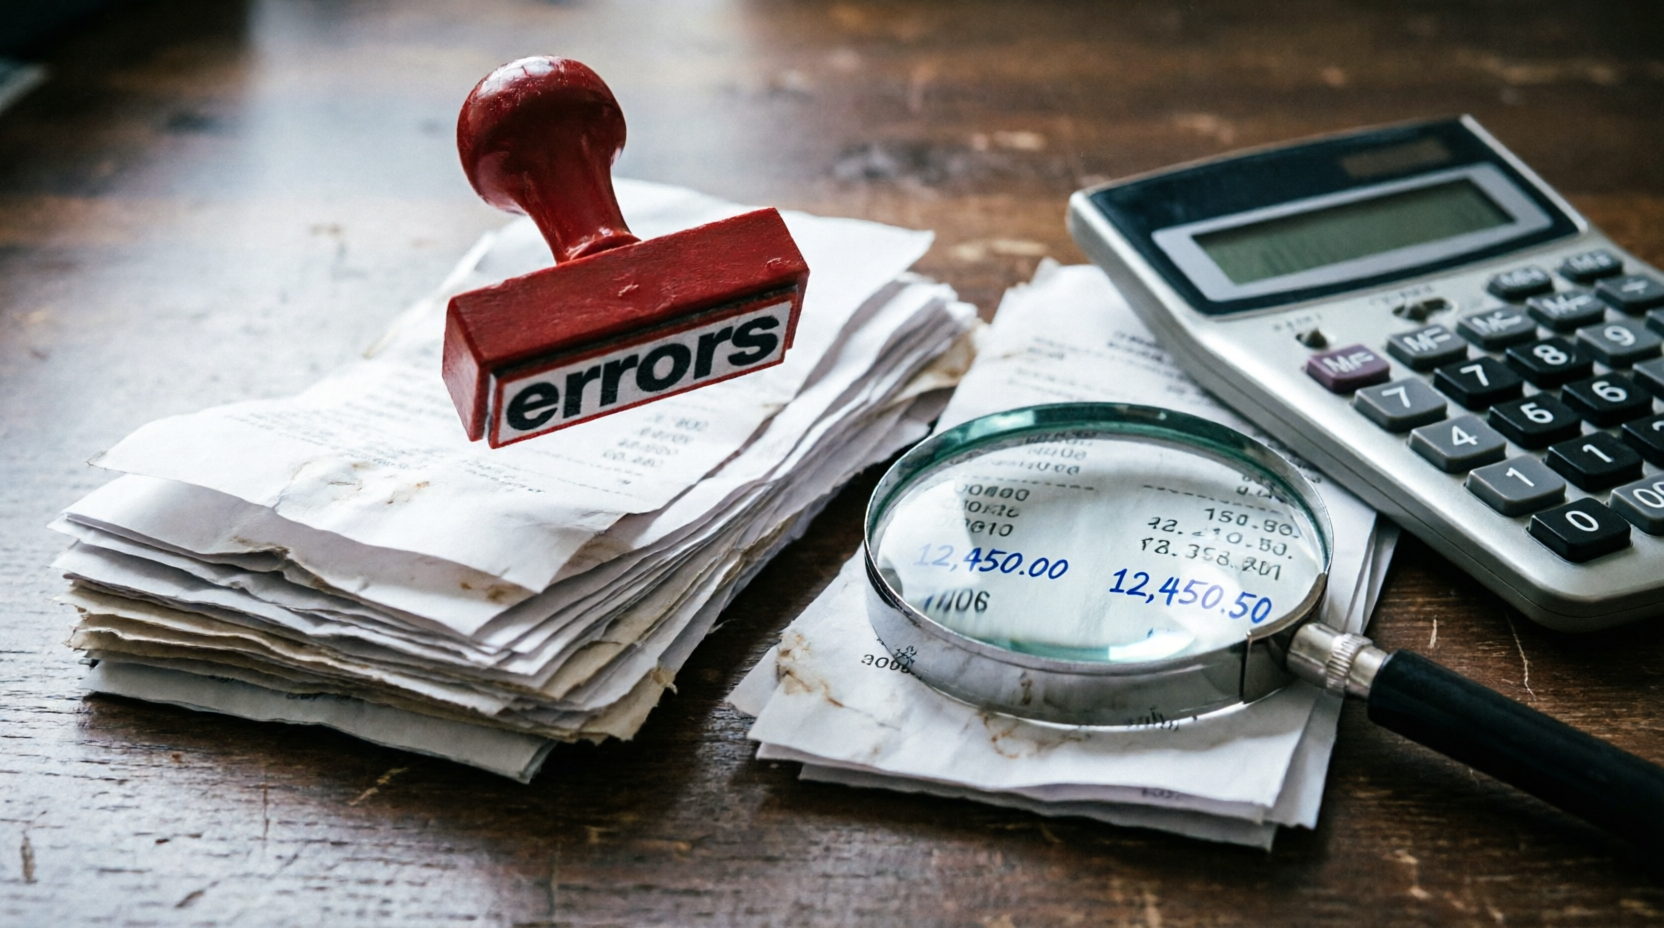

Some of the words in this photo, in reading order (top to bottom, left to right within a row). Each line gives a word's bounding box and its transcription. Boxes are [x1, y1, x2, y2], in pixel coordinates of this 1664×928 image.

[1603, 325, 1636, 347] 9
[1532, 344, 1569, 366] 8
[506, 314, 781, 432] errors
[1459, 364, 1490, 387] 7
[1381, 386, 1412, 409] 7
[1591, 380, 1628, 403] 6
[1450, 424, 1479, 447] 4
[1582, 443, 1615, 463] 1
[1505, 466, 1536, 488] 1
[1564, 510, 1600, 532] 0
[912, 543, 1069, 580] 12,450.00
[1109, 568, 1273, 625] 12,450.50
